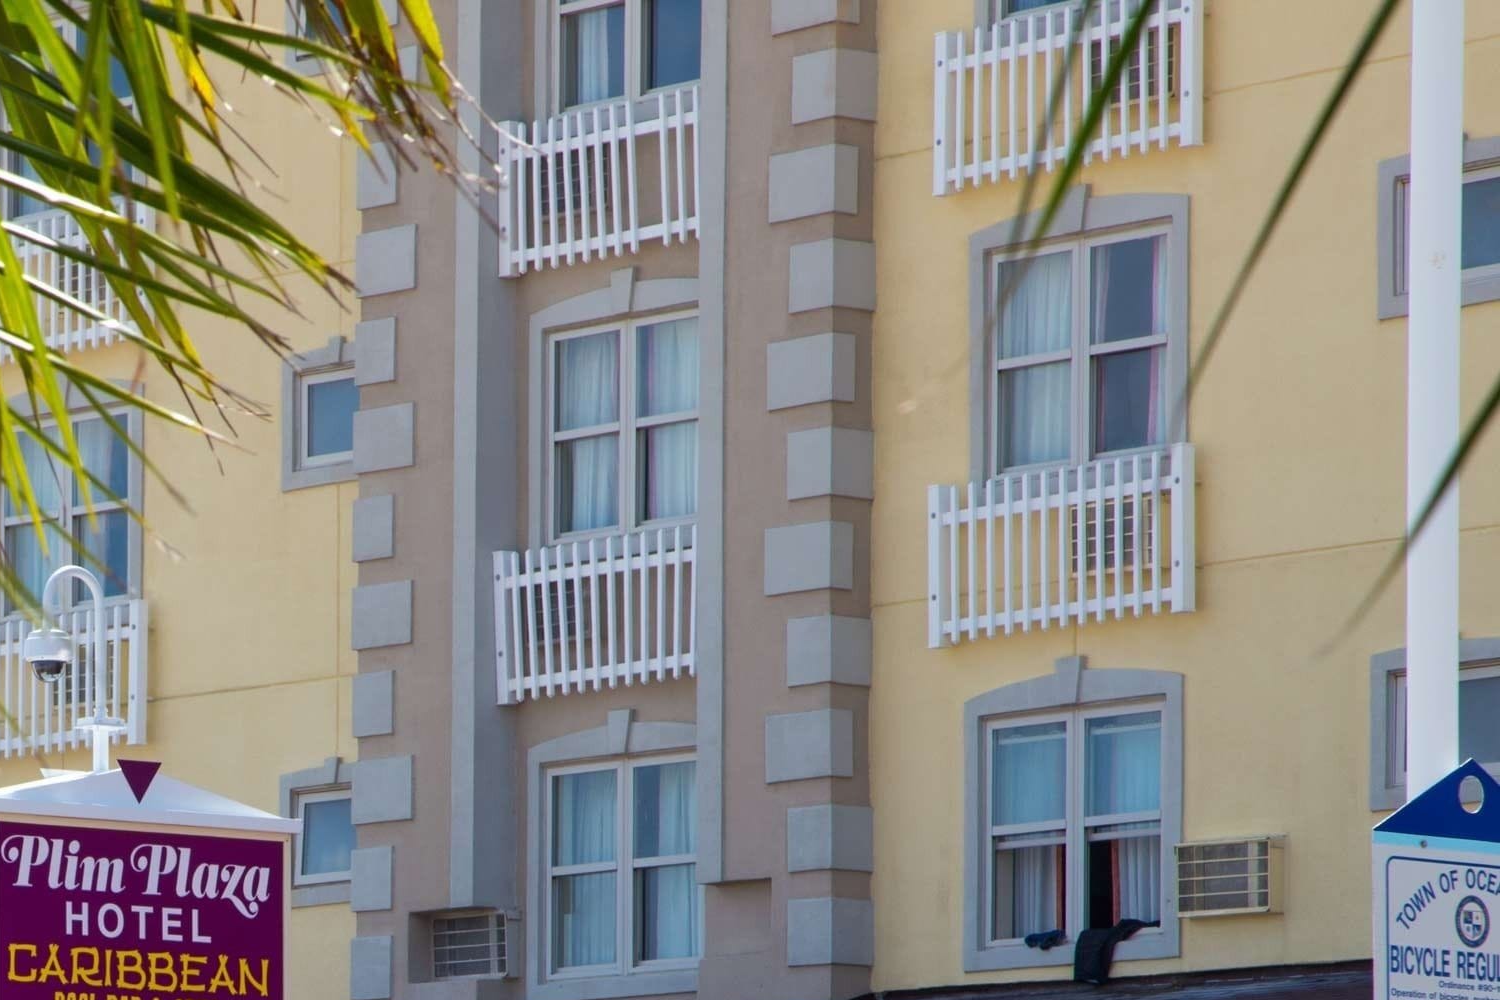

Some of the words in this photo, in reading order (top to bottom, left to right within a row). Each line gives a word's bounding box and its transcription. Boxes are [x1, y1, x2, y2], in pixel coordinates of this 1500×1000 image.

[0, 834, 126, 893] Plim
[130, 843, 270, 919] Plaza
[1396, 881, 1436, 929] TOWN
[1439, 870, 1458, 893] OF
[65, 901, 212, 943] HOTEL
[7, 943, 269, 997] CARIBBEAN
[1390, 944, 1451, 977] BICYCLE
[1390, 988, 1427, 998] Operation
[1429, 991, 1437, 999] of
[1438, 980, 1474, 991] Ordinance
